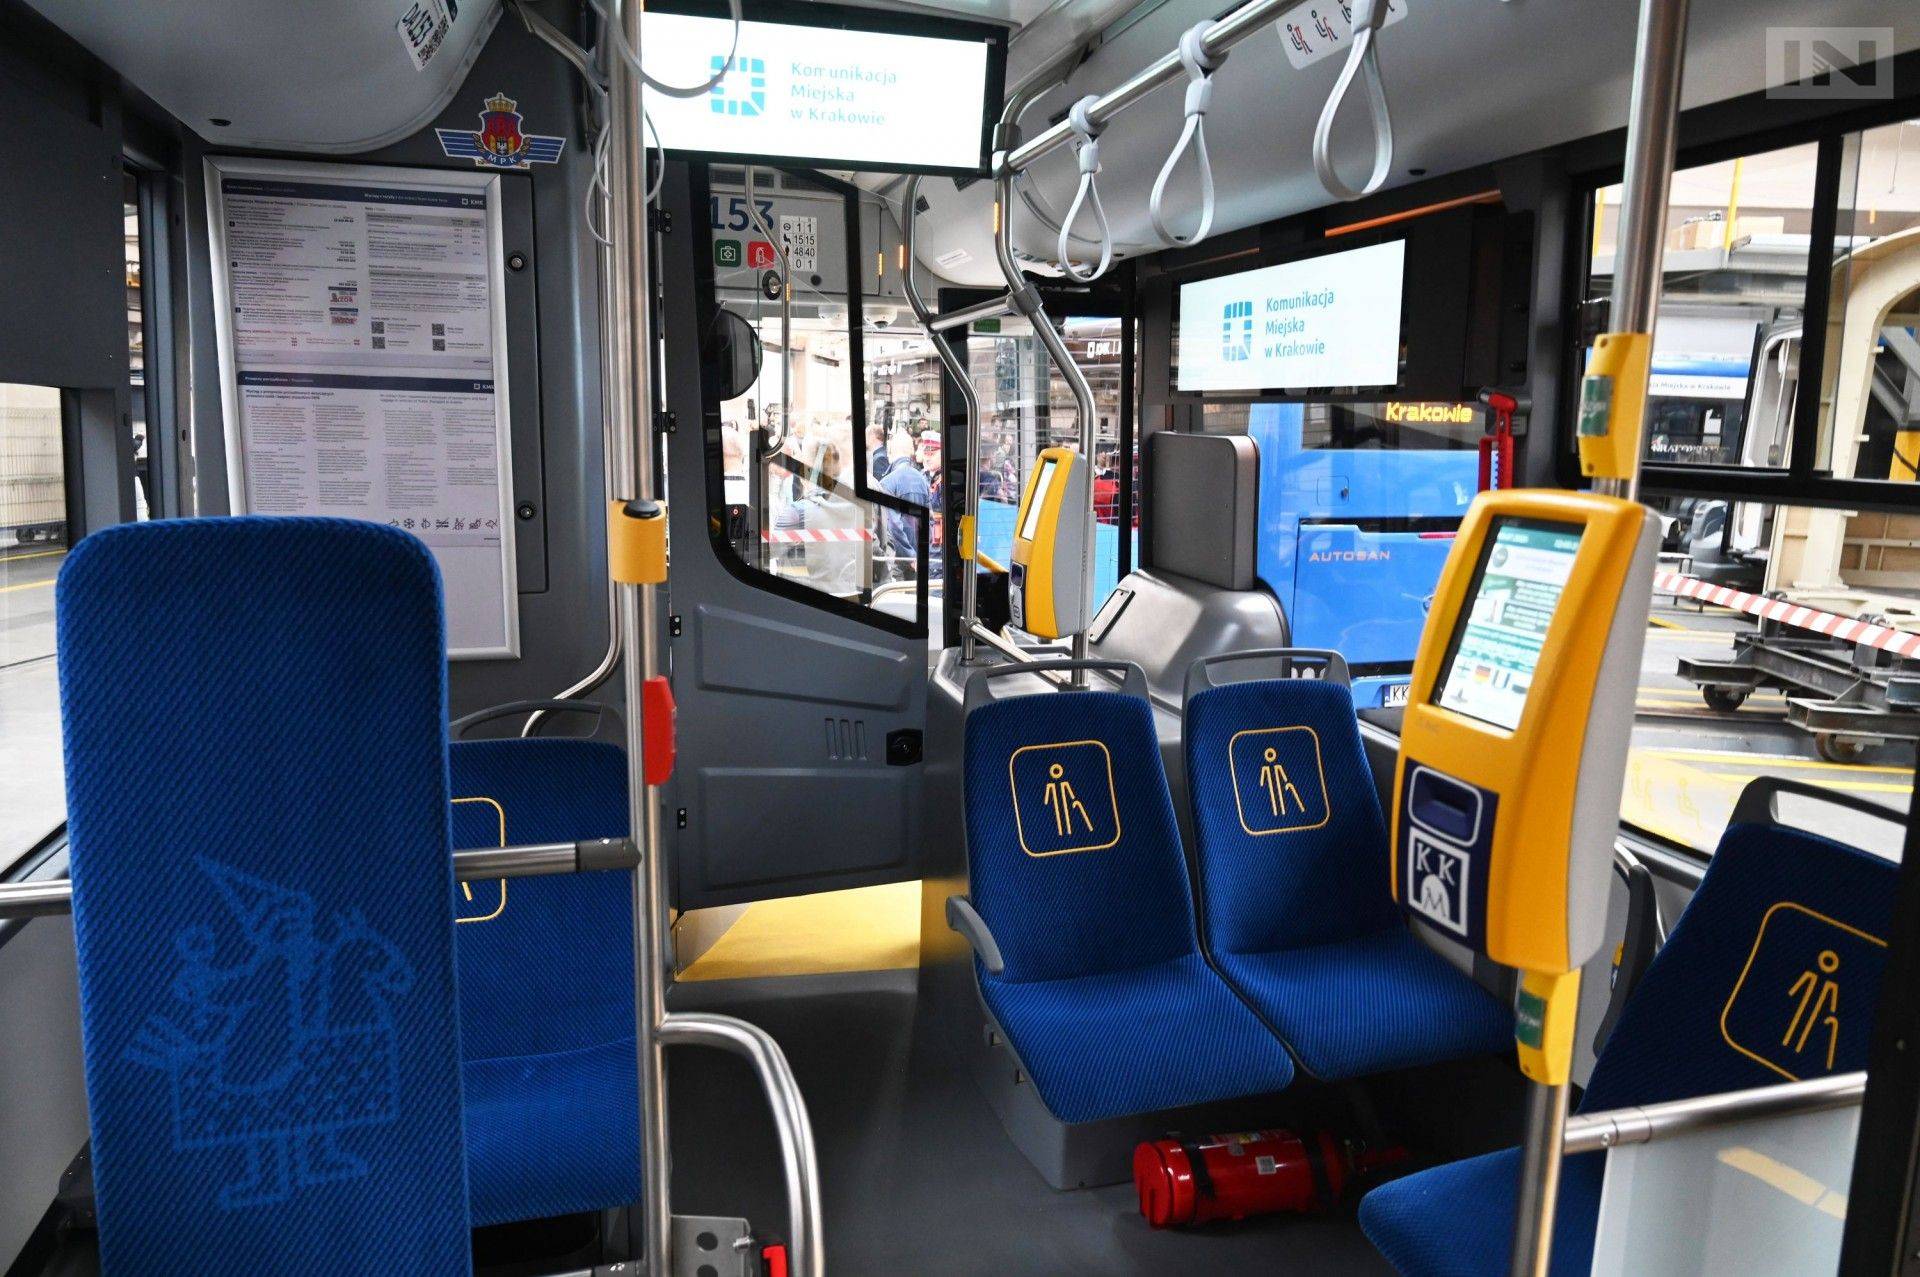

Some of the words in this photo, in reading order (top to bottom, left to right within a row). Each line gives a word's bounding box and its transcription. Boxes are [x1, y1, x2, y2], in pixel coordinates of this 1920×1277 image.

[791, 61, 897, 85] Komunikacja
[791, 84, 855, 103] Miejska
[791, 109, 802, 120] w
[809, 107, 886, 125] Krakowie
[488, 154, 516, 164] MPK
[710, 196, 775, 233] 153
[794, 234, 804, 244] 15
[805, 235, 815, 245] 15
[805, 248, 815, 257] 40
[796, 259, 802, 268] 0
[1266, 288, 1335, 313] Komunikacja
[1265, 318, 1305, 336] Miejska
[1264, 347, 1273, 358] w
[1275, 338, 1325, 358] Krakowie
[1386, 402, 1473, 423] Krakowie
[1309, 551, 1391, 562] AUTOSAN
